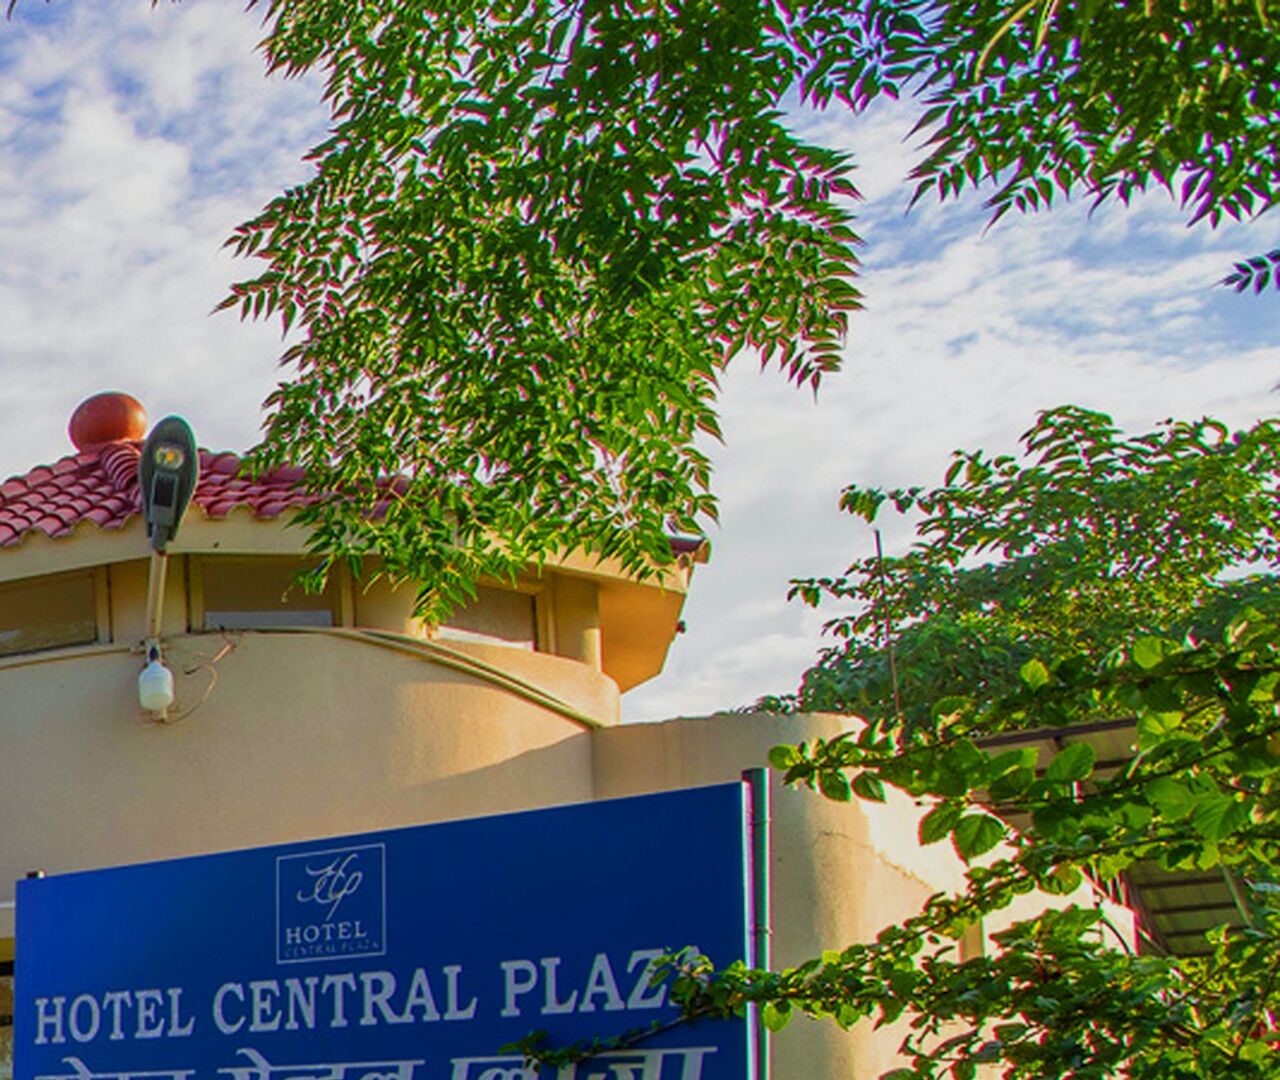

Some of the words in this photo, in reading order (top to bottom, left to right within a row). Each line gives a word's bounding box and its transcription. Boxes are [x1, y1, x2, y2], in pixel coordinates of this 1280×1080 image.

[285, 920, 367, 944] HOTEL
[34, 987, 195, 1045] HOTEL
[212, 964, 478, 1035] CENTRAL
